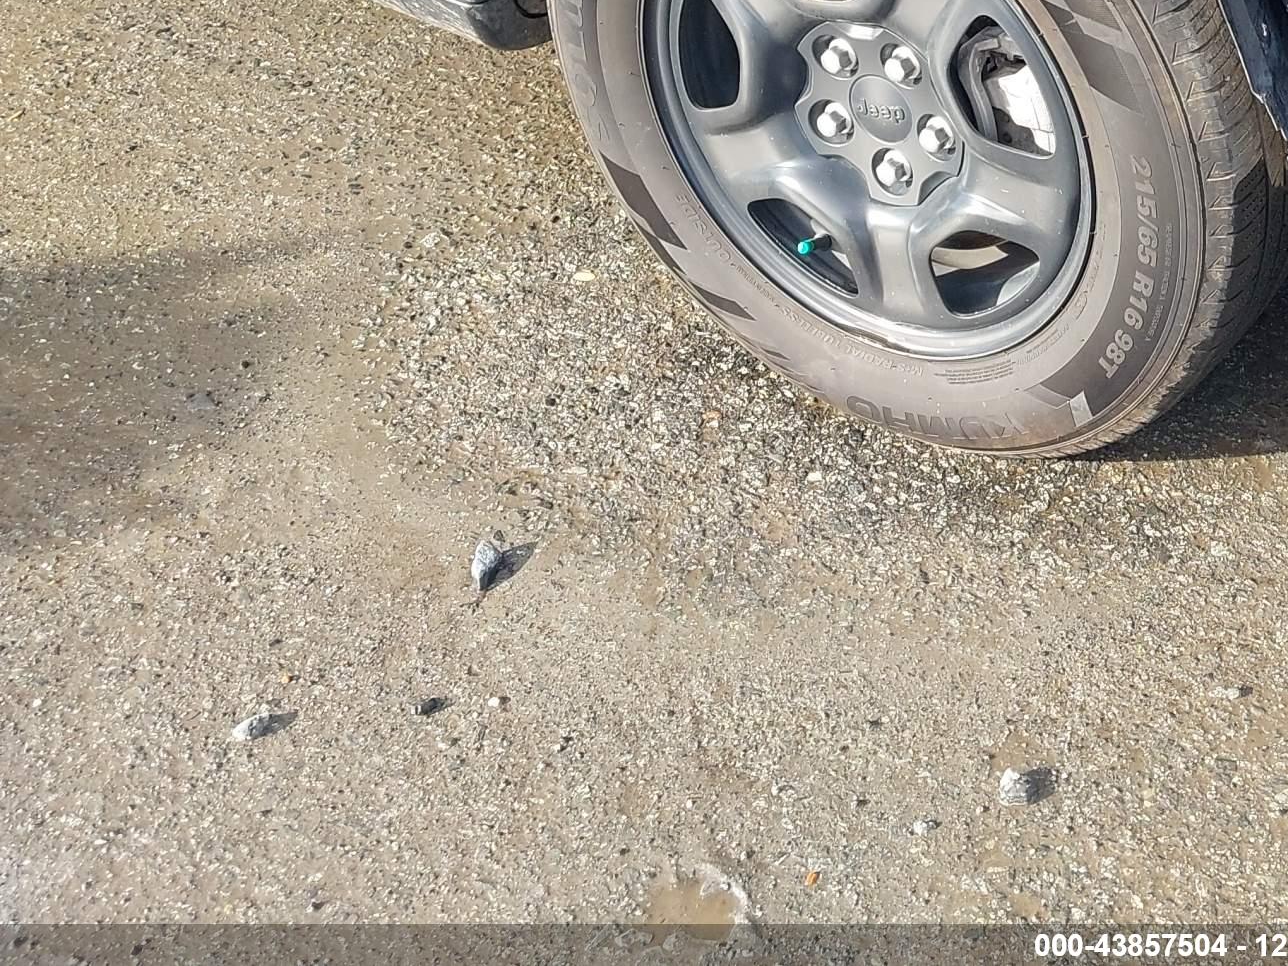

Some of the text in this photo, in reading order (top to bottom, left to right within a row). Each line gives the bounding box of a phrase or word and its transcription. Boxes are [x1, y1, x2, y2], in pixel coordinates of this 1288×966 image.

[1098, 154, 1159, 379] 215/65 R16 98T
[846, 394, 1029, 440] KUMHO
